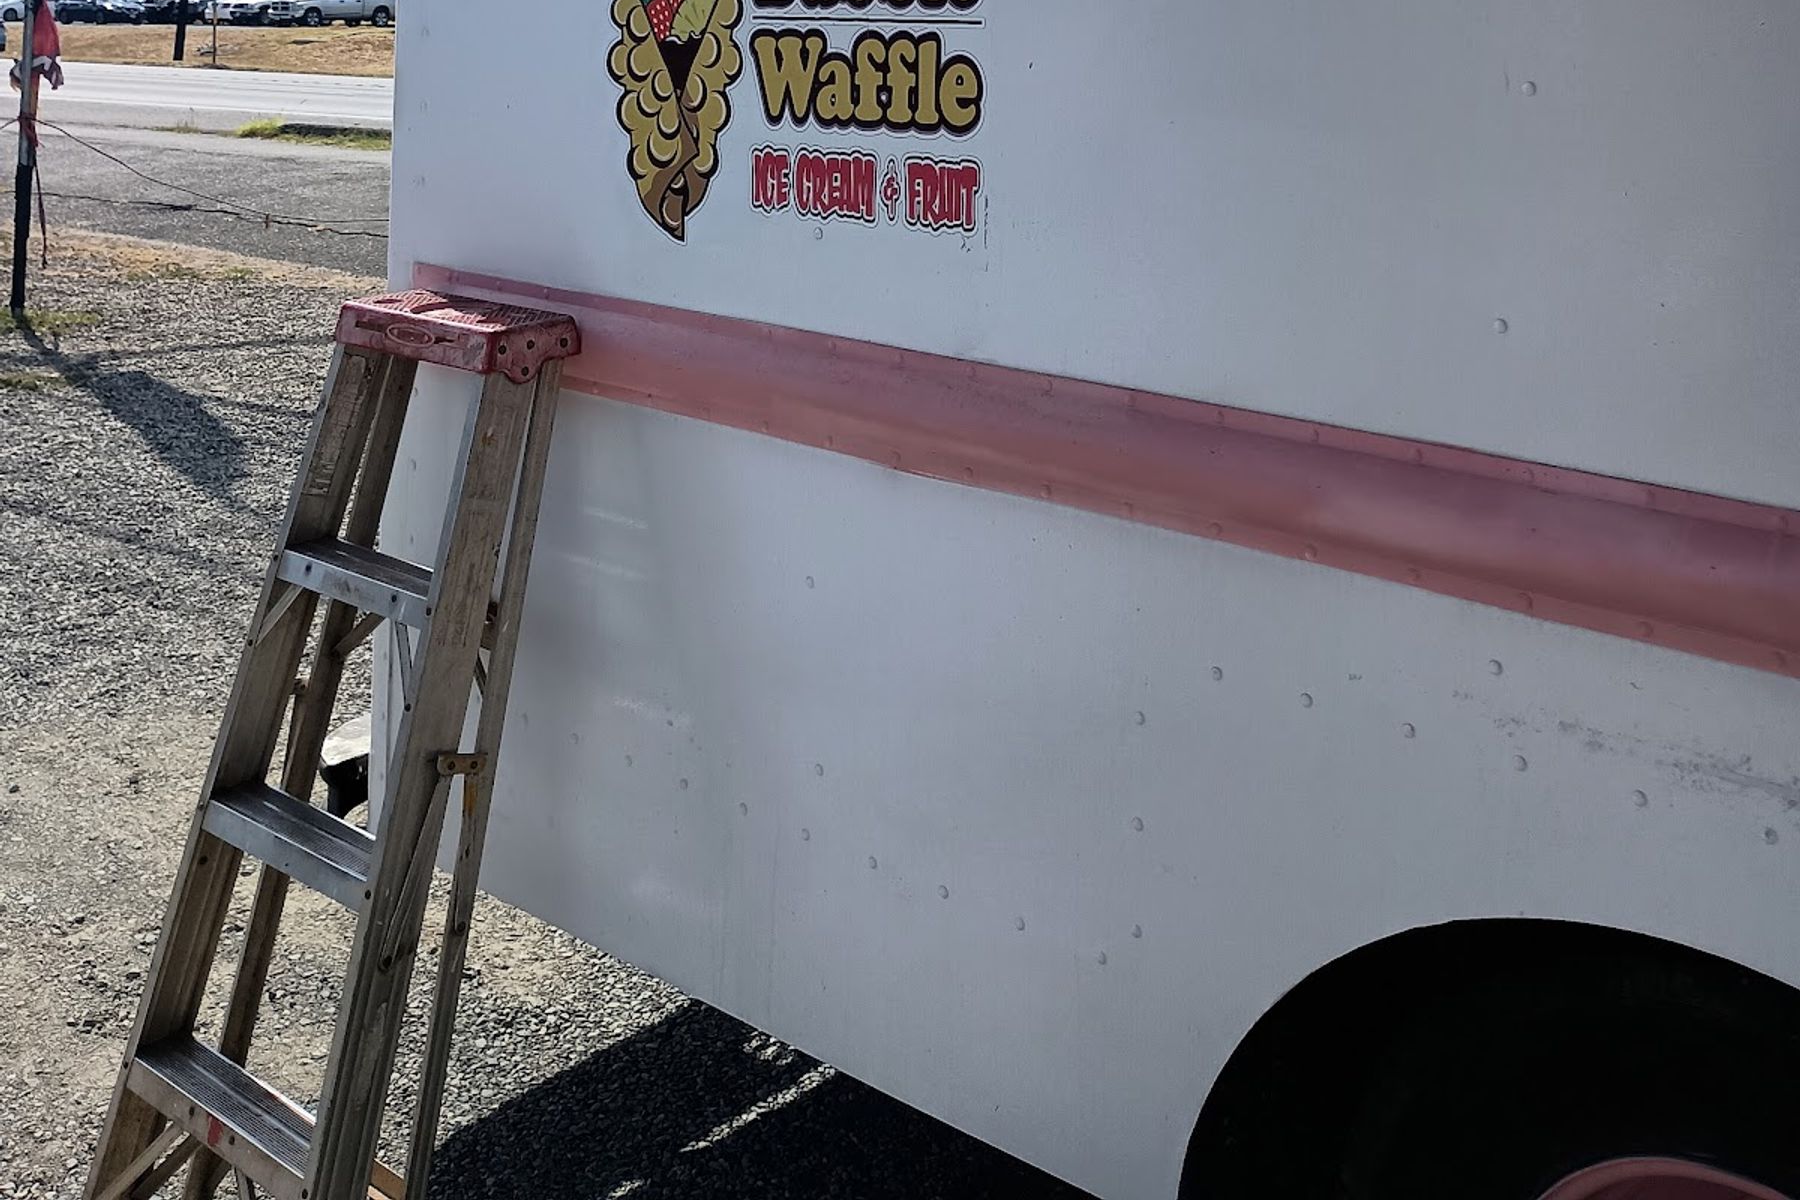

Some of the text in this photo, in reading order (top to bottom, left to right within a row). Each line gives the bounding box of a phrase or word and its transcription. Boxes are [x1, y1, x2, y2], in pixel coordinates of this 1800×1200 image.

[751, 28, 984, 136] Waffle
[752, 150, 979, 229] ICE CREAM & FRUIT
